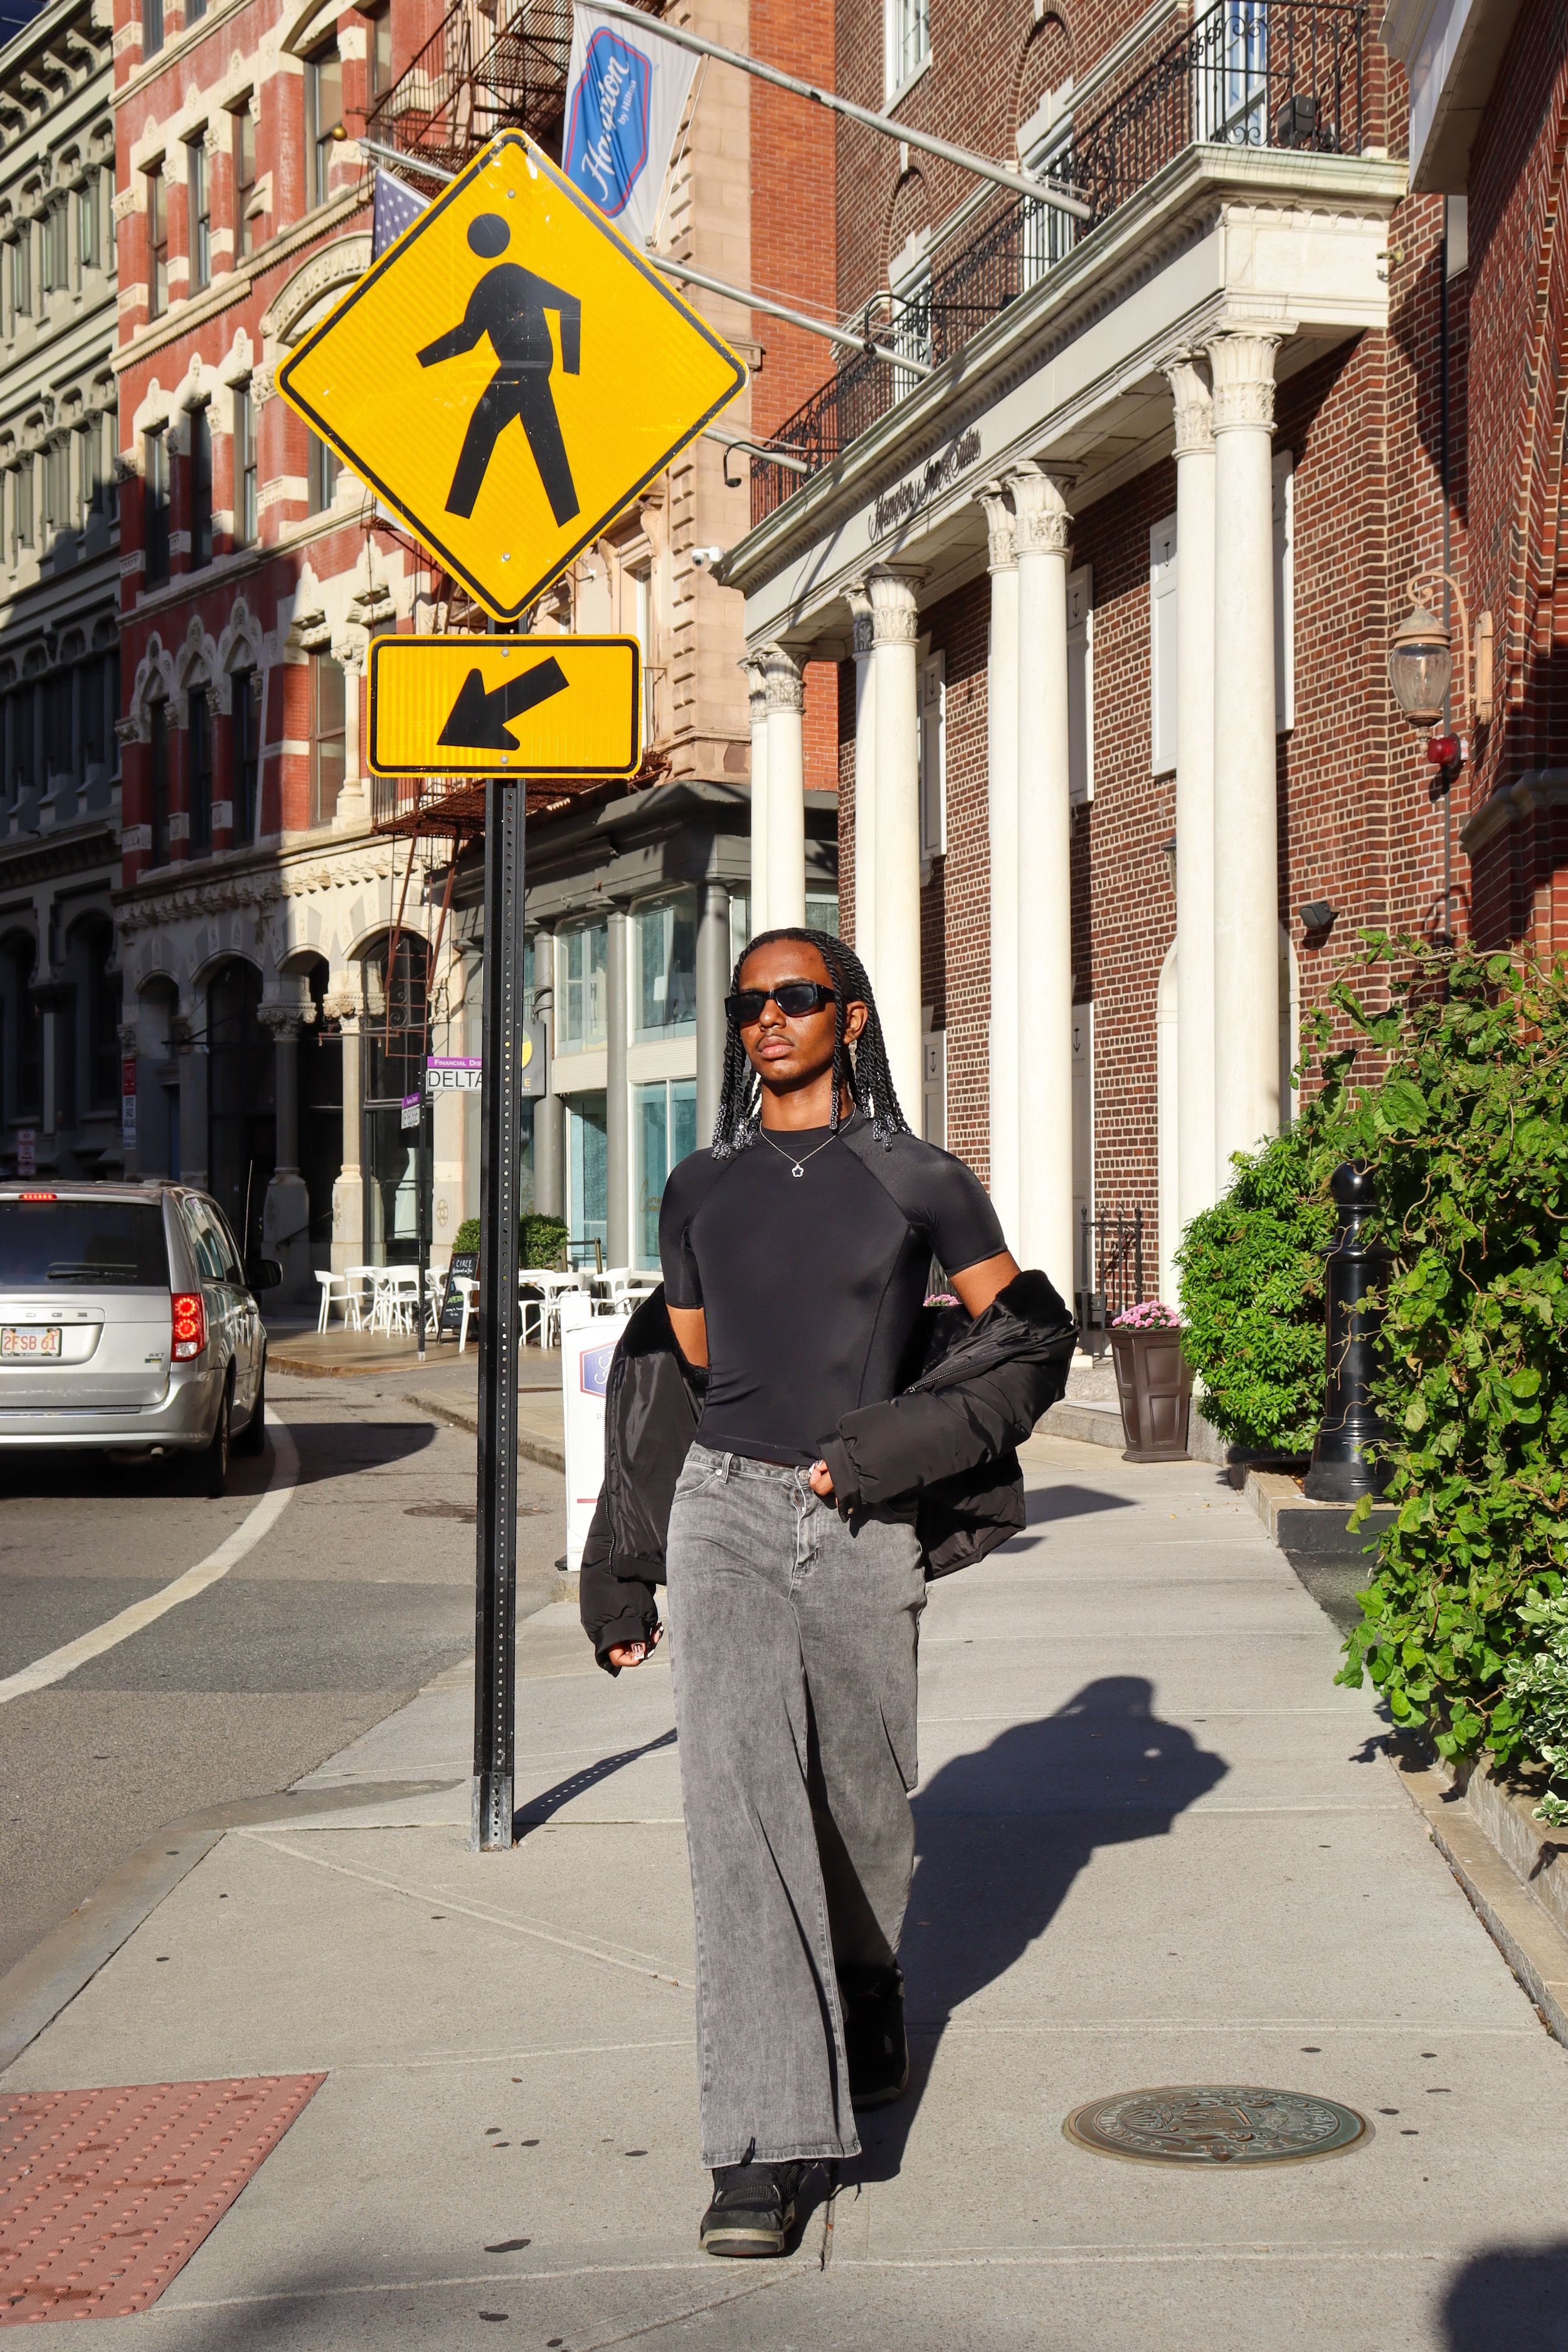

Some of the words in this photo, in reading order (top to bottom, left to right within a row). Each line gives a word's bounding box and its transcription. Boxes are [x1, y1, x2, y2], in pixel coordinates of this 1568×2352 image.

[622, 80, 636, 111] Hilton
[618, 108, 629, 125] by
[868, 480, 917, 540] Hampton
[918, 458, 944, 506] Inn
[951, 427, 982, 477] Suites
[3, 1335, 37, 1350] 2FSB
[41, 1335, 56, 1350] 61
[1189, 2089, 1334, 2141] INDEPENDENCE
[1197, 2137, 1300, 2154] TRAIL
